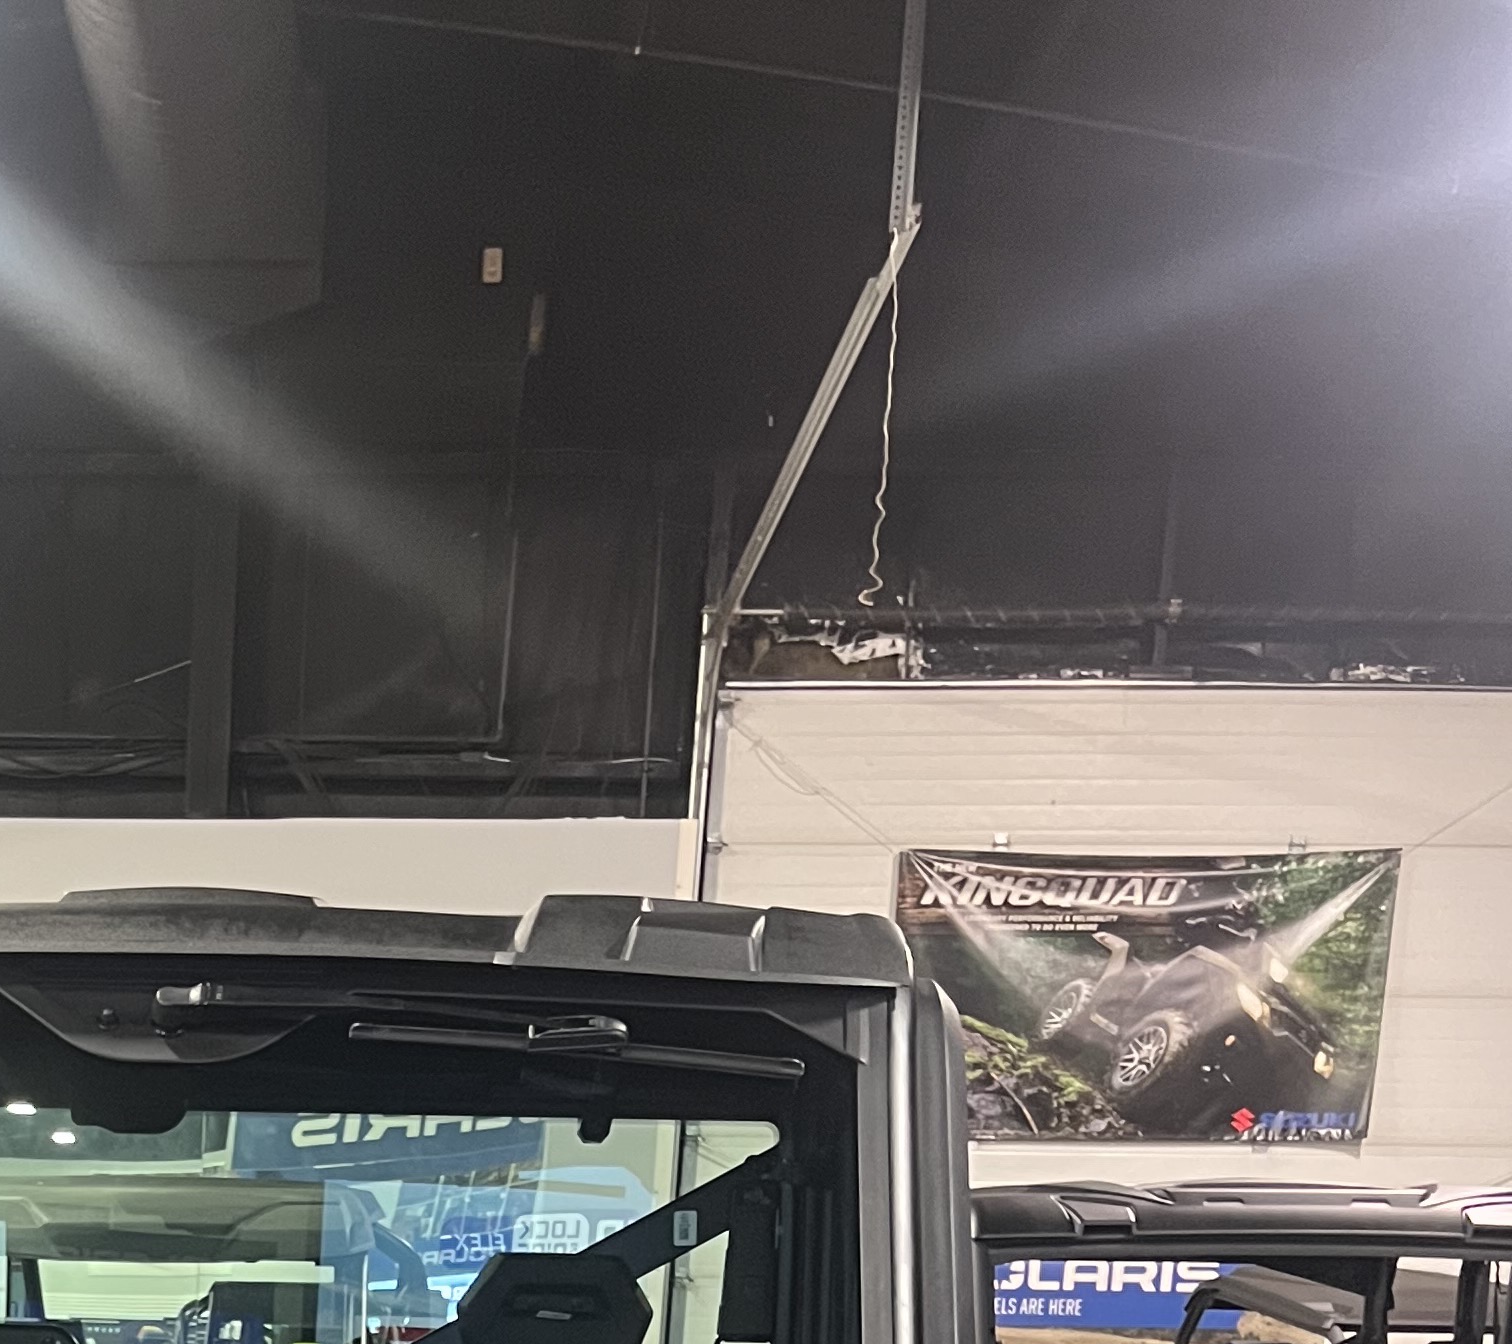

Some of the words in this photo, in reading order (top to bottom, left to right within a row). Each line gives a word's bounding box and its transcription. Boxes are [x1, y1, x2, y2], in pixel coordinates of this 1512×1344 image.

[920, 876, 1187, 907] KINGQUAD
[993, 1259, 1221, 1293] OLARIS
[994, 1297, 1018, 1315] ELS
[1019, 1297, 1045, 1316] ARE
[1048, 1298, 1083, 1317] HERE
